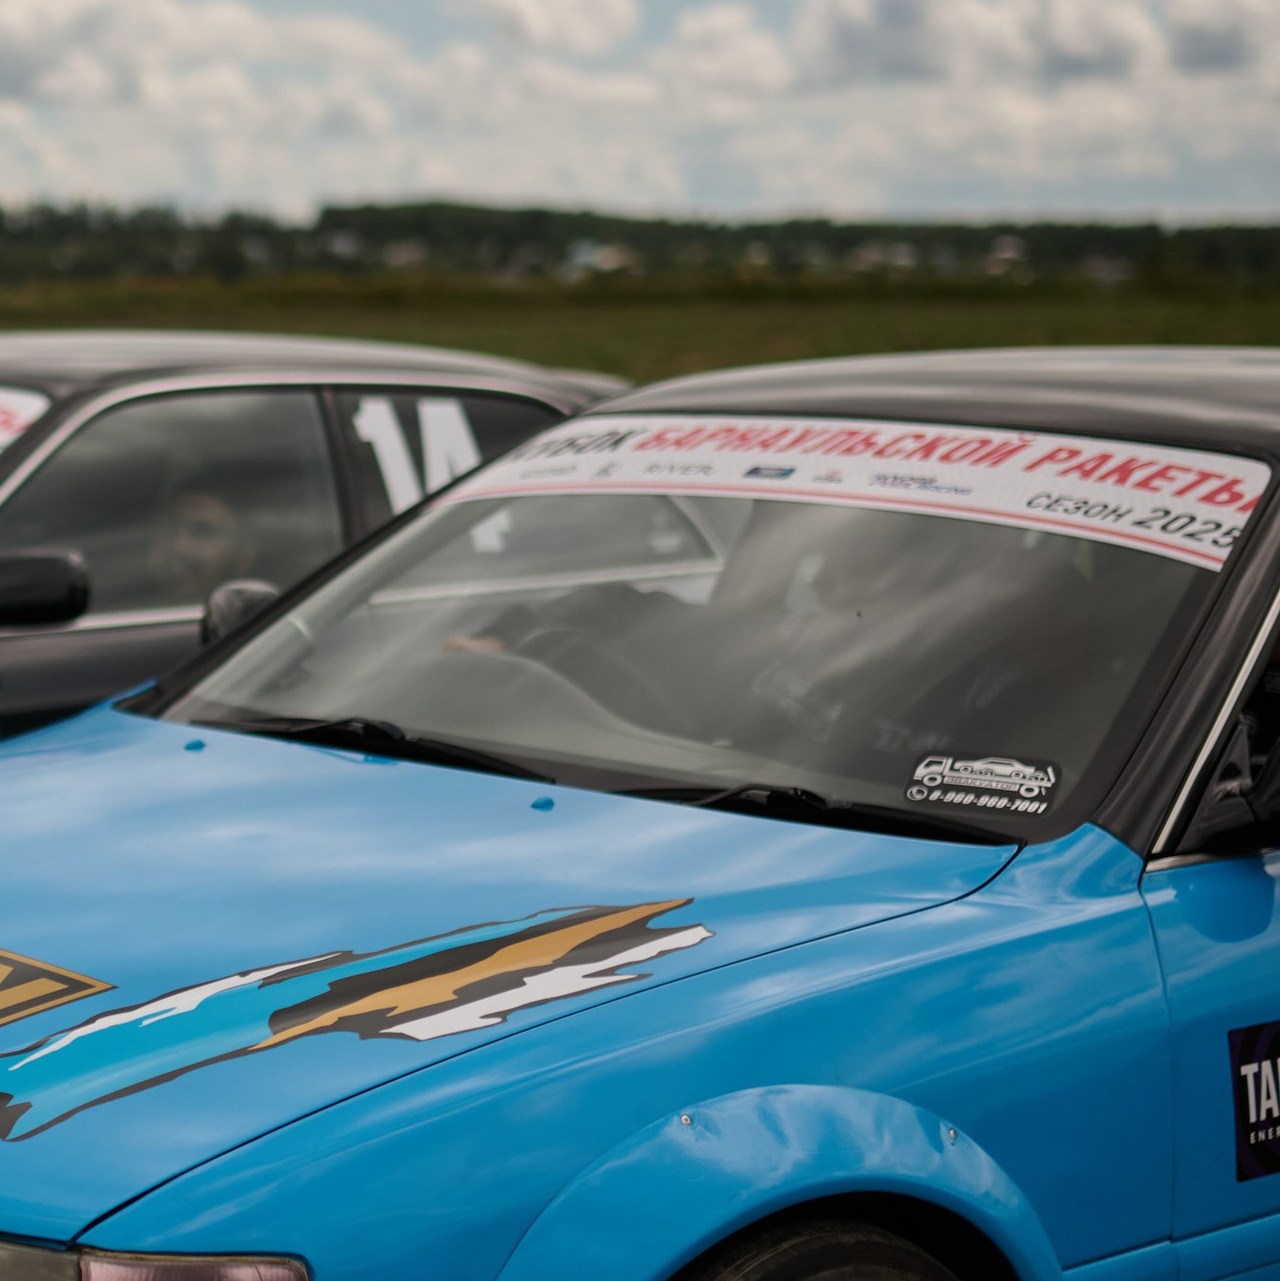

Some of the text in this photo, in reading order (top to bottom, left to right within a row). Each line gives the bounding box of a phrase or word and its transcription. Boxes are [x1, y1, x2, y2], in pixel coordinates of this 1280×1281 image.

[632, 425, 1037, 469] БАРНАУЛЬСКОЙ
[1023, 446, 1264, 514] РАКЕТЫ
[1026, 491, 1241, 548] СЕЗОН 2025
[1240, 1057, 1280, 1123] TA
